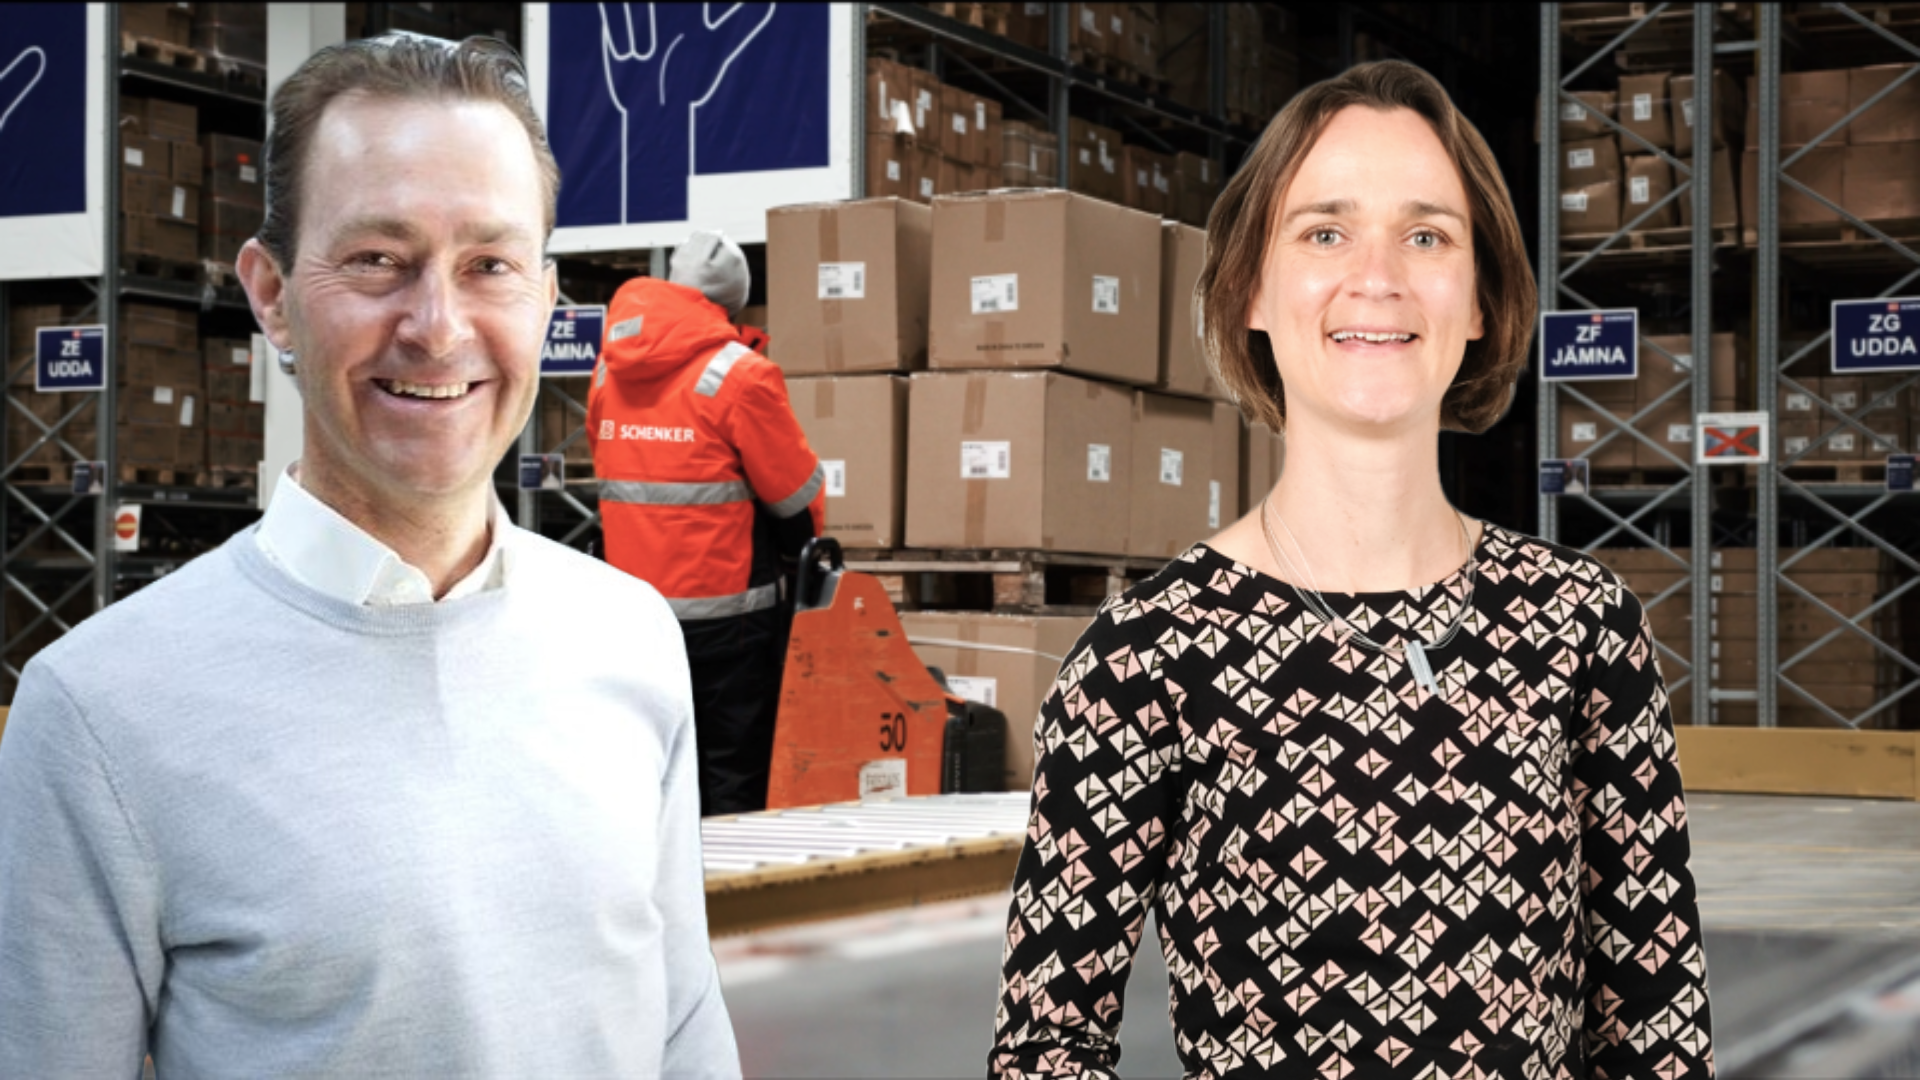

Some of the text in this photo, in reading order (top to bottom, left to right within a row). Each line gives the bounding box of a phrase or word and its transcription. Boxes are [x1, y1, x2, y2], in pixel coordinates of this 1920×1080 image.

[551, 320, 577, 339] ZE
[1867, 313, 1901, 332] ZG
[1575, 325, 1602, 343] ZF
[60, 339, 82, 356] ZE
[541, 341, 595, 359] ÄMNA
[1551, 344, 1627, 366] JÄMNA
[1851, 336, 1917, 356] UDDA
[47, 360, 94, 377] UDDA
[620, 424, 695, 443] SCHENKER
[880, 713, 907, 751] 50
